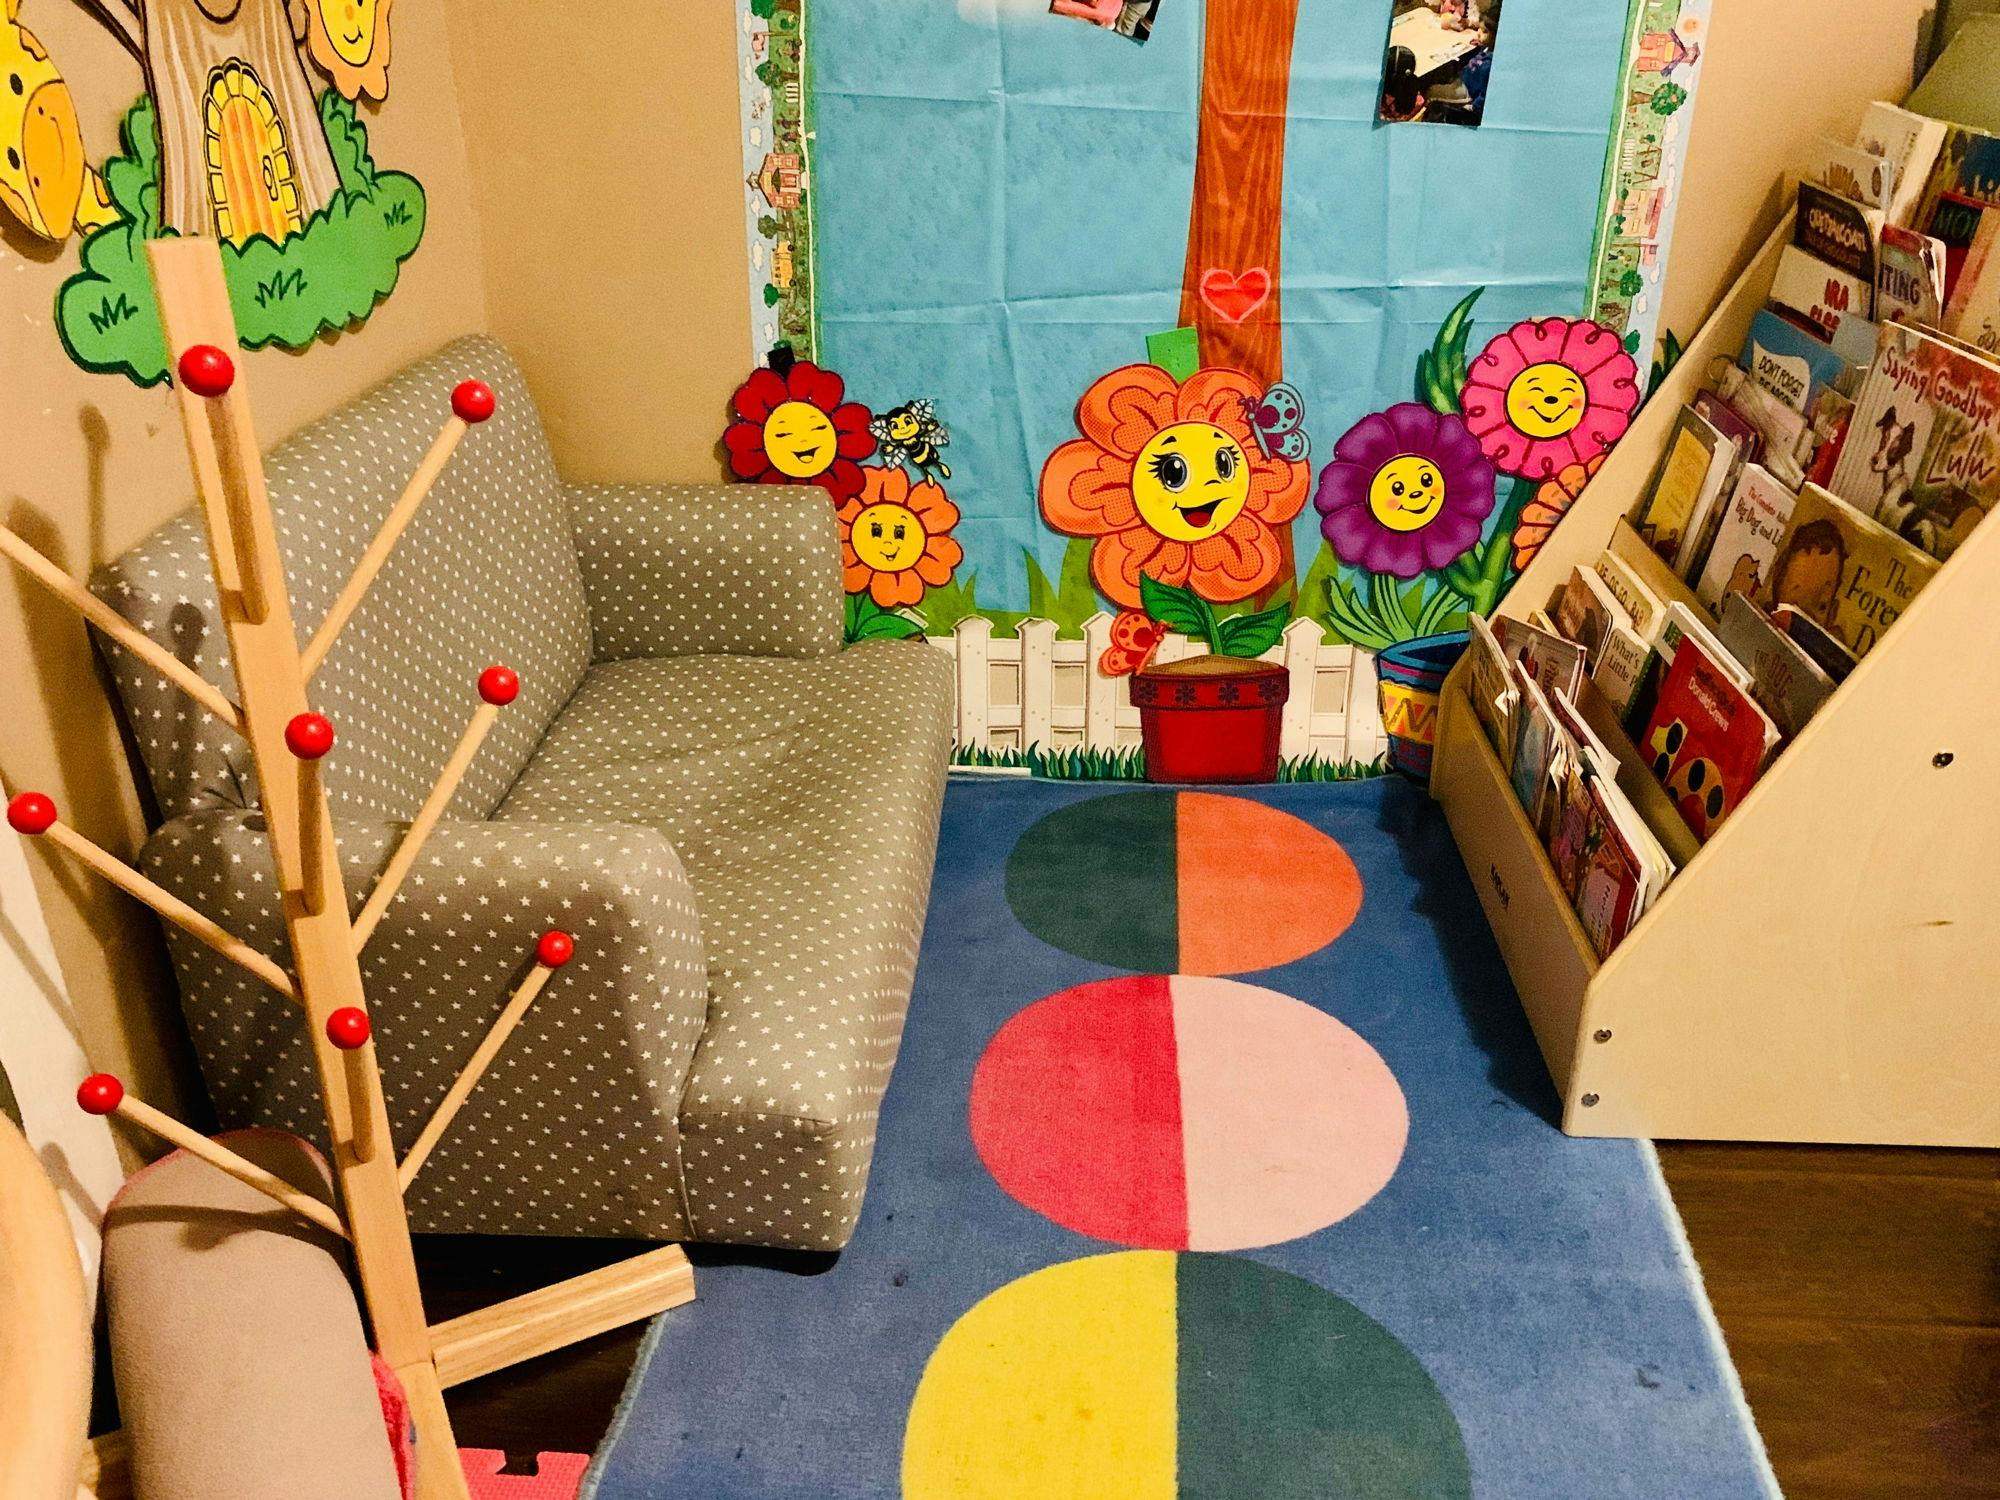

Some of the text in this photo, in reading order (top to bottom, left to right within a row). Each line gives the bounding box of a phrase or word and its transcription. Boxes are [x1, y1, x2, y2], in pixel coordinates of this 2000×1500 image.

[1882, 346, 1992, 433] Saying Goodbye
[1926, 431, 1997, 485] Lulu
[1736, 496, 1749, 524] Big
[1746, 507, 1762, 536] Dog
[1759, 525, 1774, 541] and
[1844, 565, 1901, 627] Fore
[1885, 557, 1913, 600] The
[1607, 654, 1630, 682] Little
[1612, 635, 1640, 671] What's
[1688, 675, 1712, 710] Donald
[1707, 701, 1730, 733] Crews
